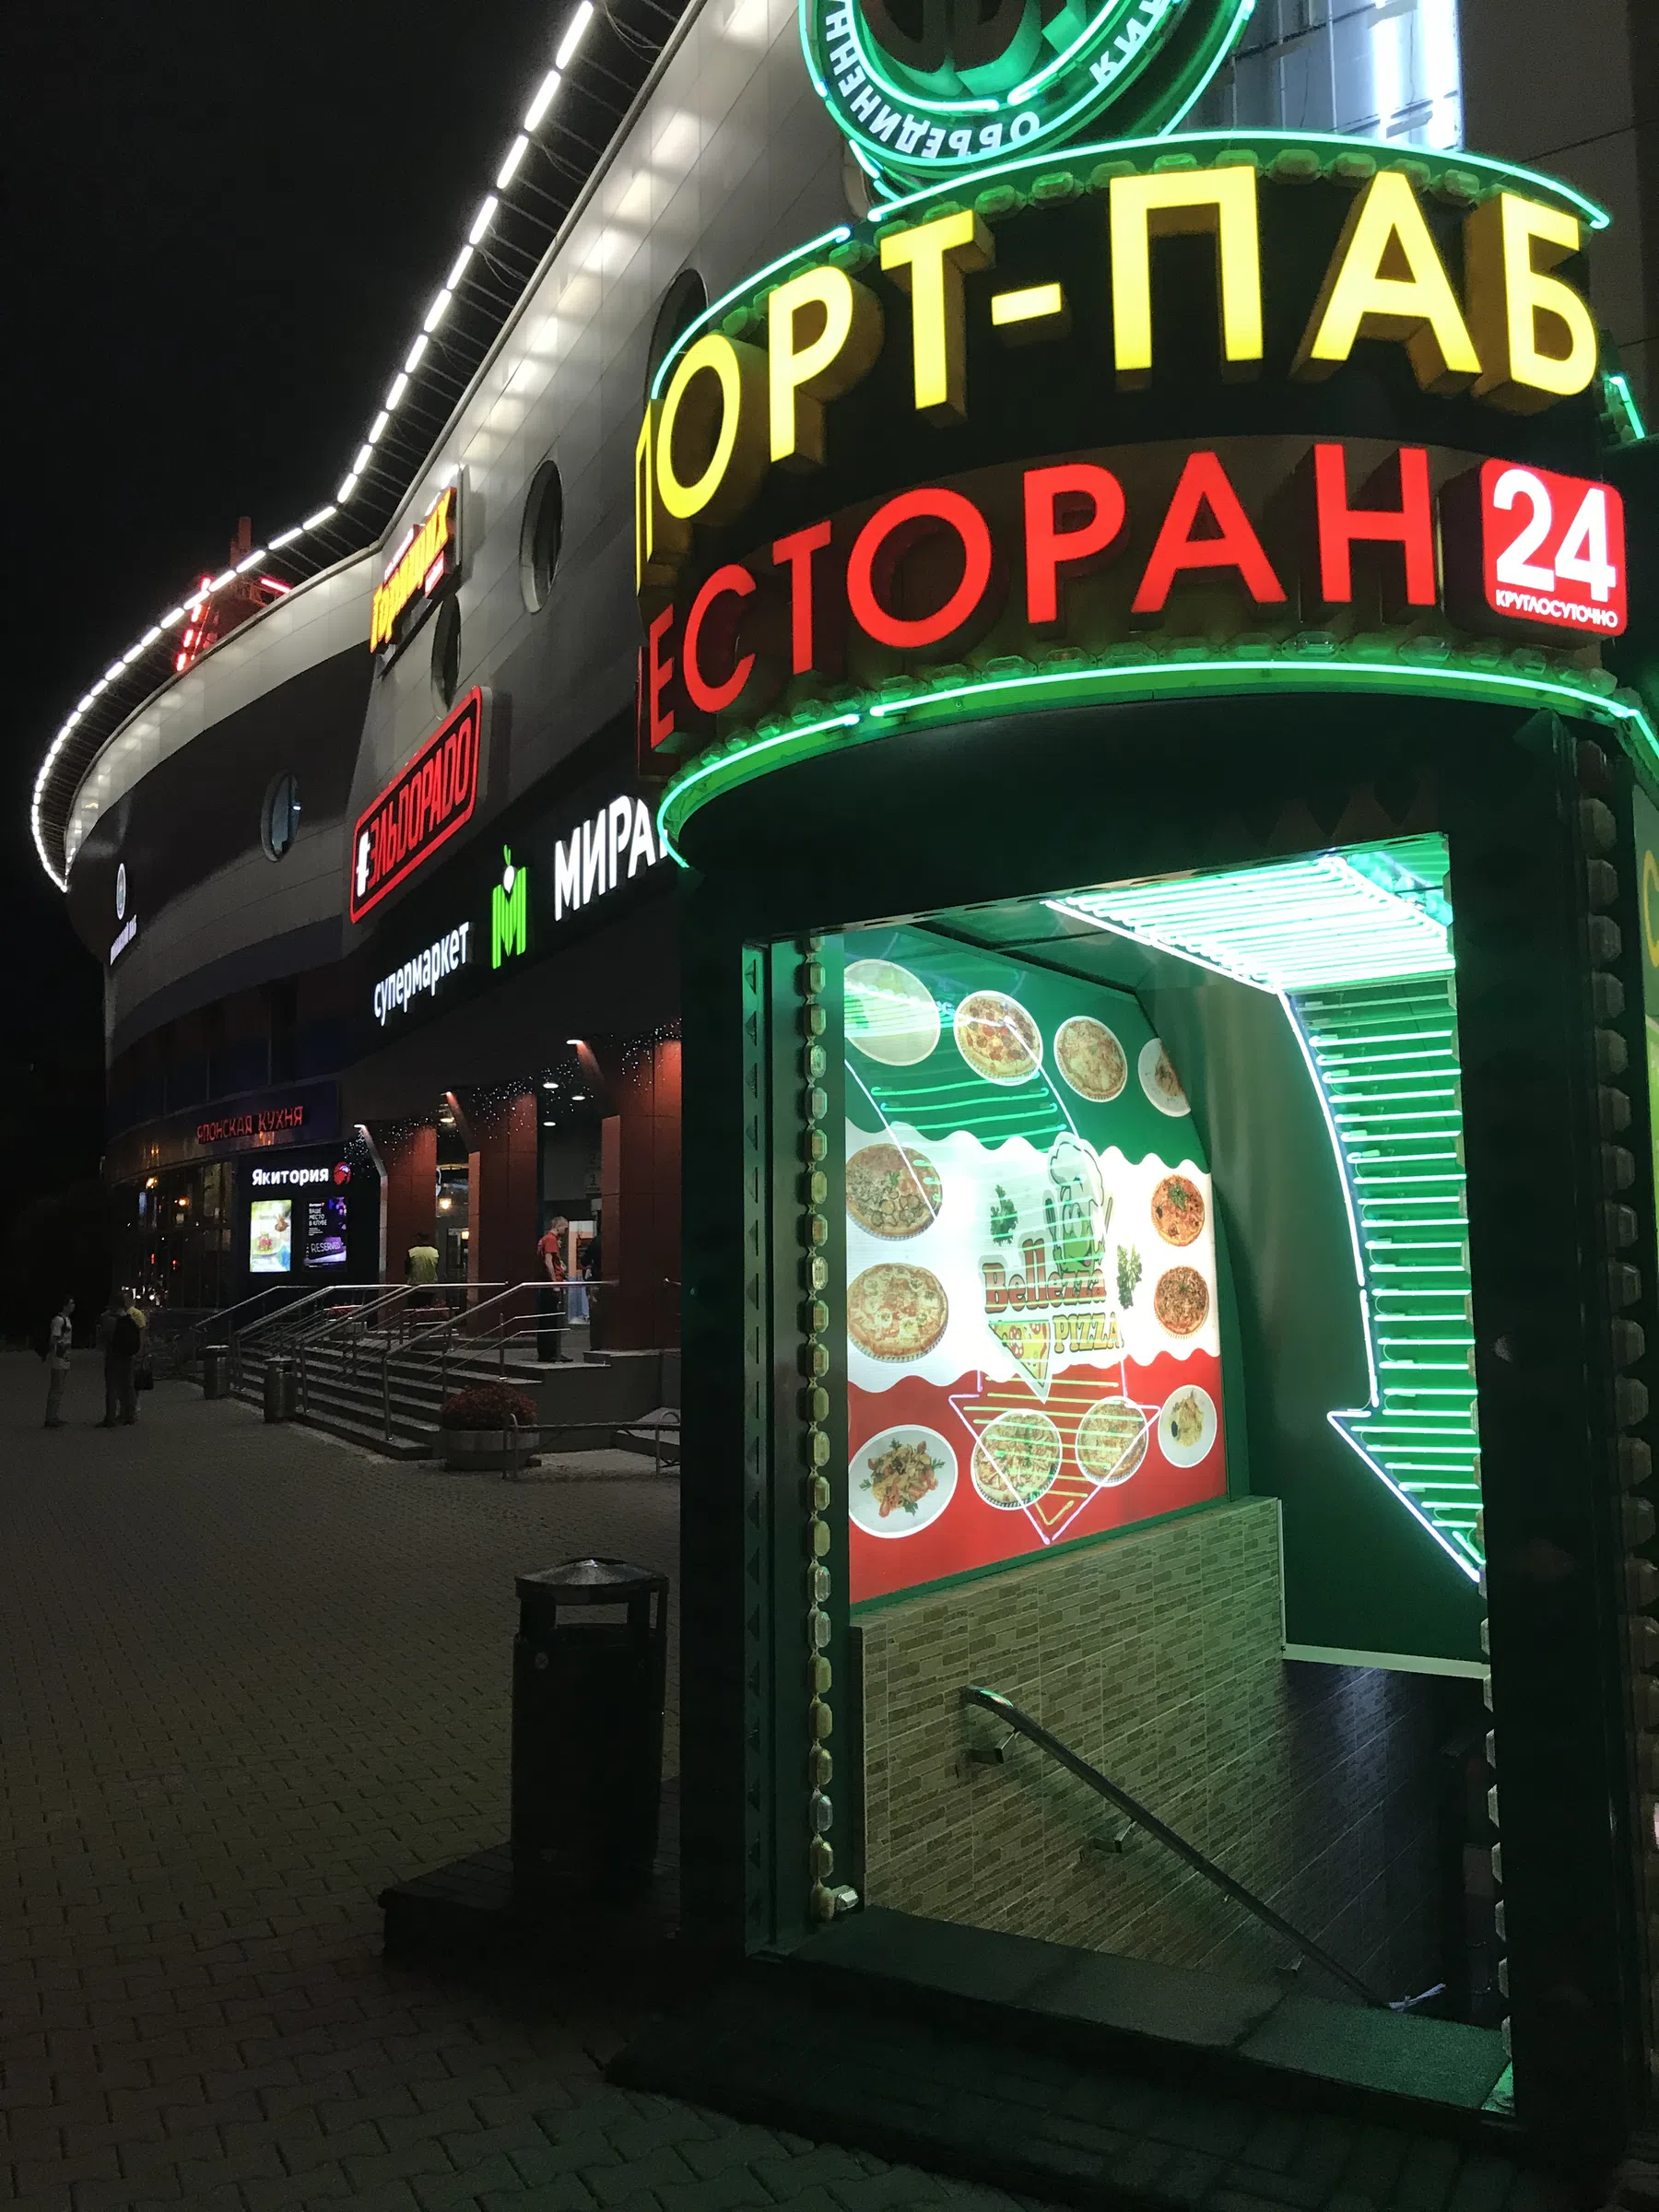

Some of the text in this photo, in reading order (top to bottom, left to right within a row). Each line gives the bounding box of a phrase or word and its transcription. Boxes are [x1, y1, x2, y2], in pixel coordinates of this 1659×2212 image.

[825, 0, 1041, 159] ОБЪЕДИНЕНН
[1493, 468, 1617, 603] 24
[636, 443, 1436, 770] ЕСТОРАН
[1495, 589, 1618, 628] КРУГЛОСУТОЧНО
[374, 921, 469, 1027] супермаркет
[196, 1106, 304, 1143] ЯПОНСКАЯ КУХНЯ
[252, 1168, 329, 1186] Якитория
[311, 1241, 342, 1253] RESERVED
[982, 1238, 1107, 1314] Bellezza
[1053, 1311, 1124, 1353] PIZZA
